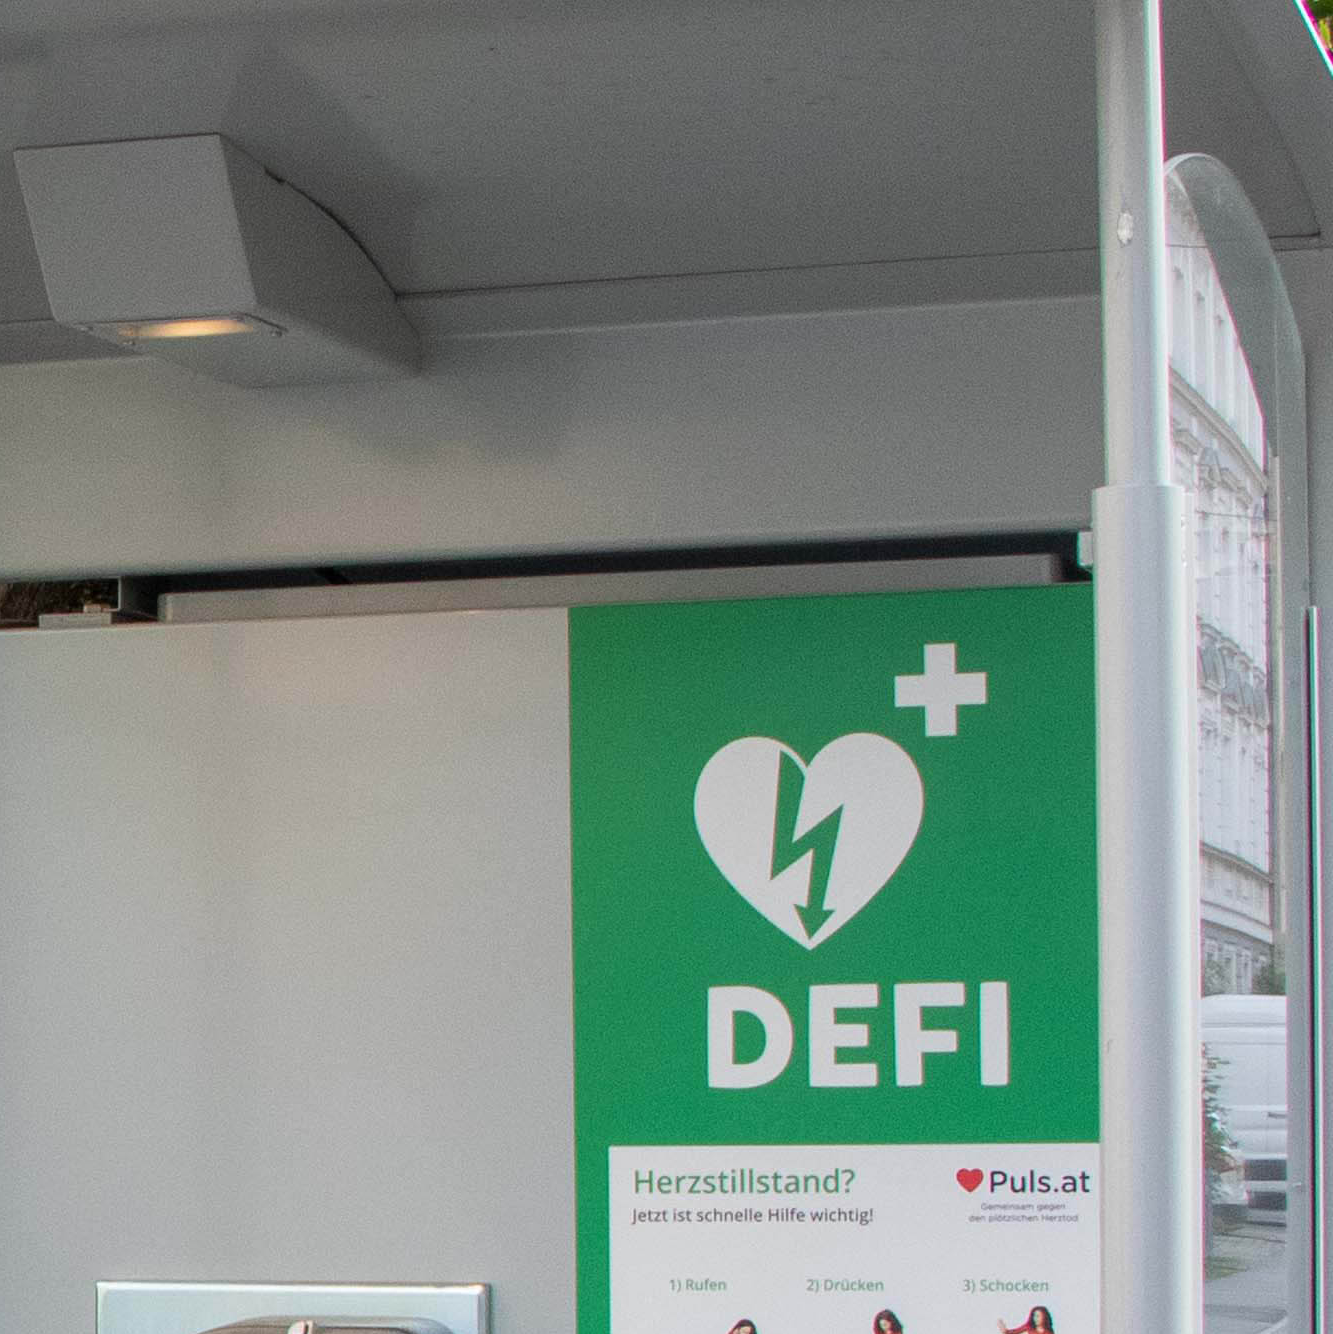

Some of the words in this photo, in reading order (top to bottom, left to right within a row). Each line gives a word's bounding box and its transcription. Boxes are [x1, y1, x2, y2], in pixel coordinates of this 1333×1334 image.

[707, 981, 1010, 1089] DEFI
[633, 1168, 857, 1195] Herzstillstand?
[989, 1169, 1091, 1193] Puls.at
[631, 1208, 668, 1225] Jetzt
[673, 1208, 692, 1223] ist
[696, 1208, 763, 1223] schnelle
[768, 1208, 806, 1223] Hilfe
[810, 1208, 874, 1226] wichtig!
[669, 1279, 682, 1293] 1)
[685, 1278, 728, 1292] Rufen
[806, 1279, 820, 1294] 2)
[823, 1277, 885, 1292] Drücken
[963, 1279, 976, 1294] 3)
[979, 1278, 1050, 1293] Schocken
